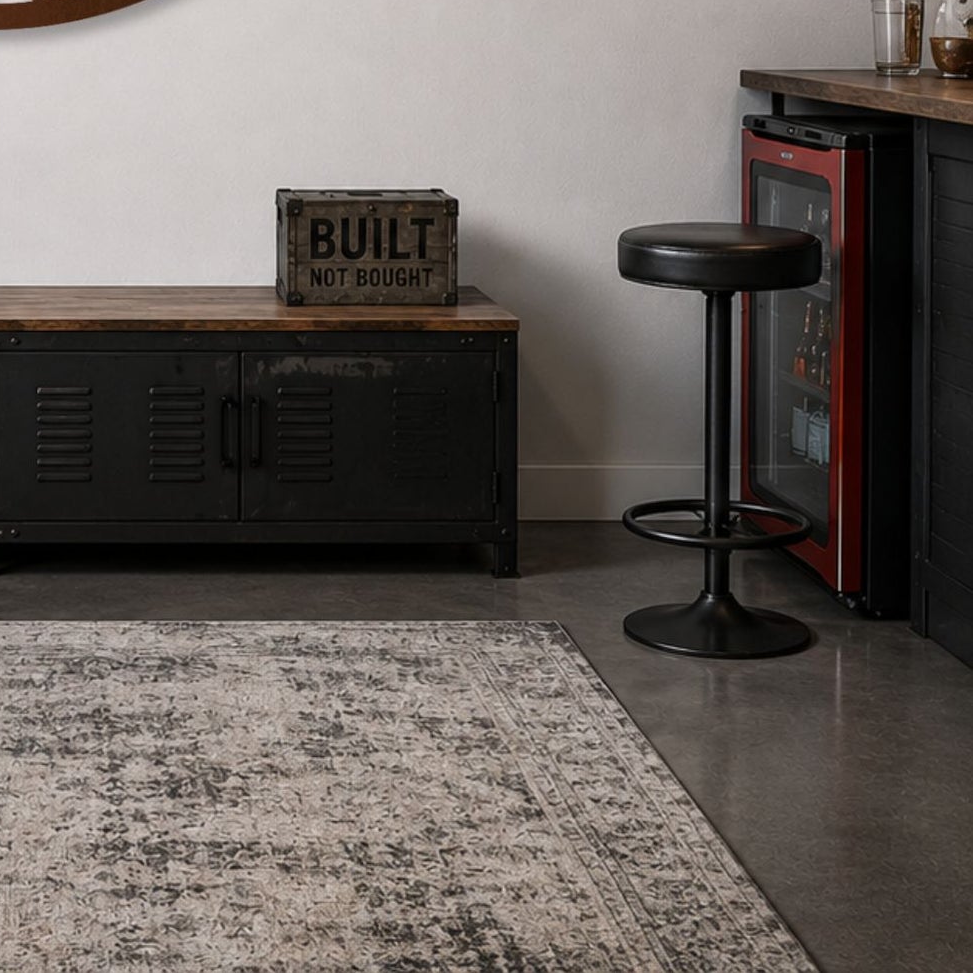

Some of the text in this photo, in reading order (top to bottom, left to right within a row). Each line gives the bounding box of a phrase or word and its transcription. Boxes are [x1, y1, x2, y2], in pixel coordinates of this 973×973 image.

[310, 217, 435, 260] BUILT
[310, 267, 433, 288] NOT BOUGHT
